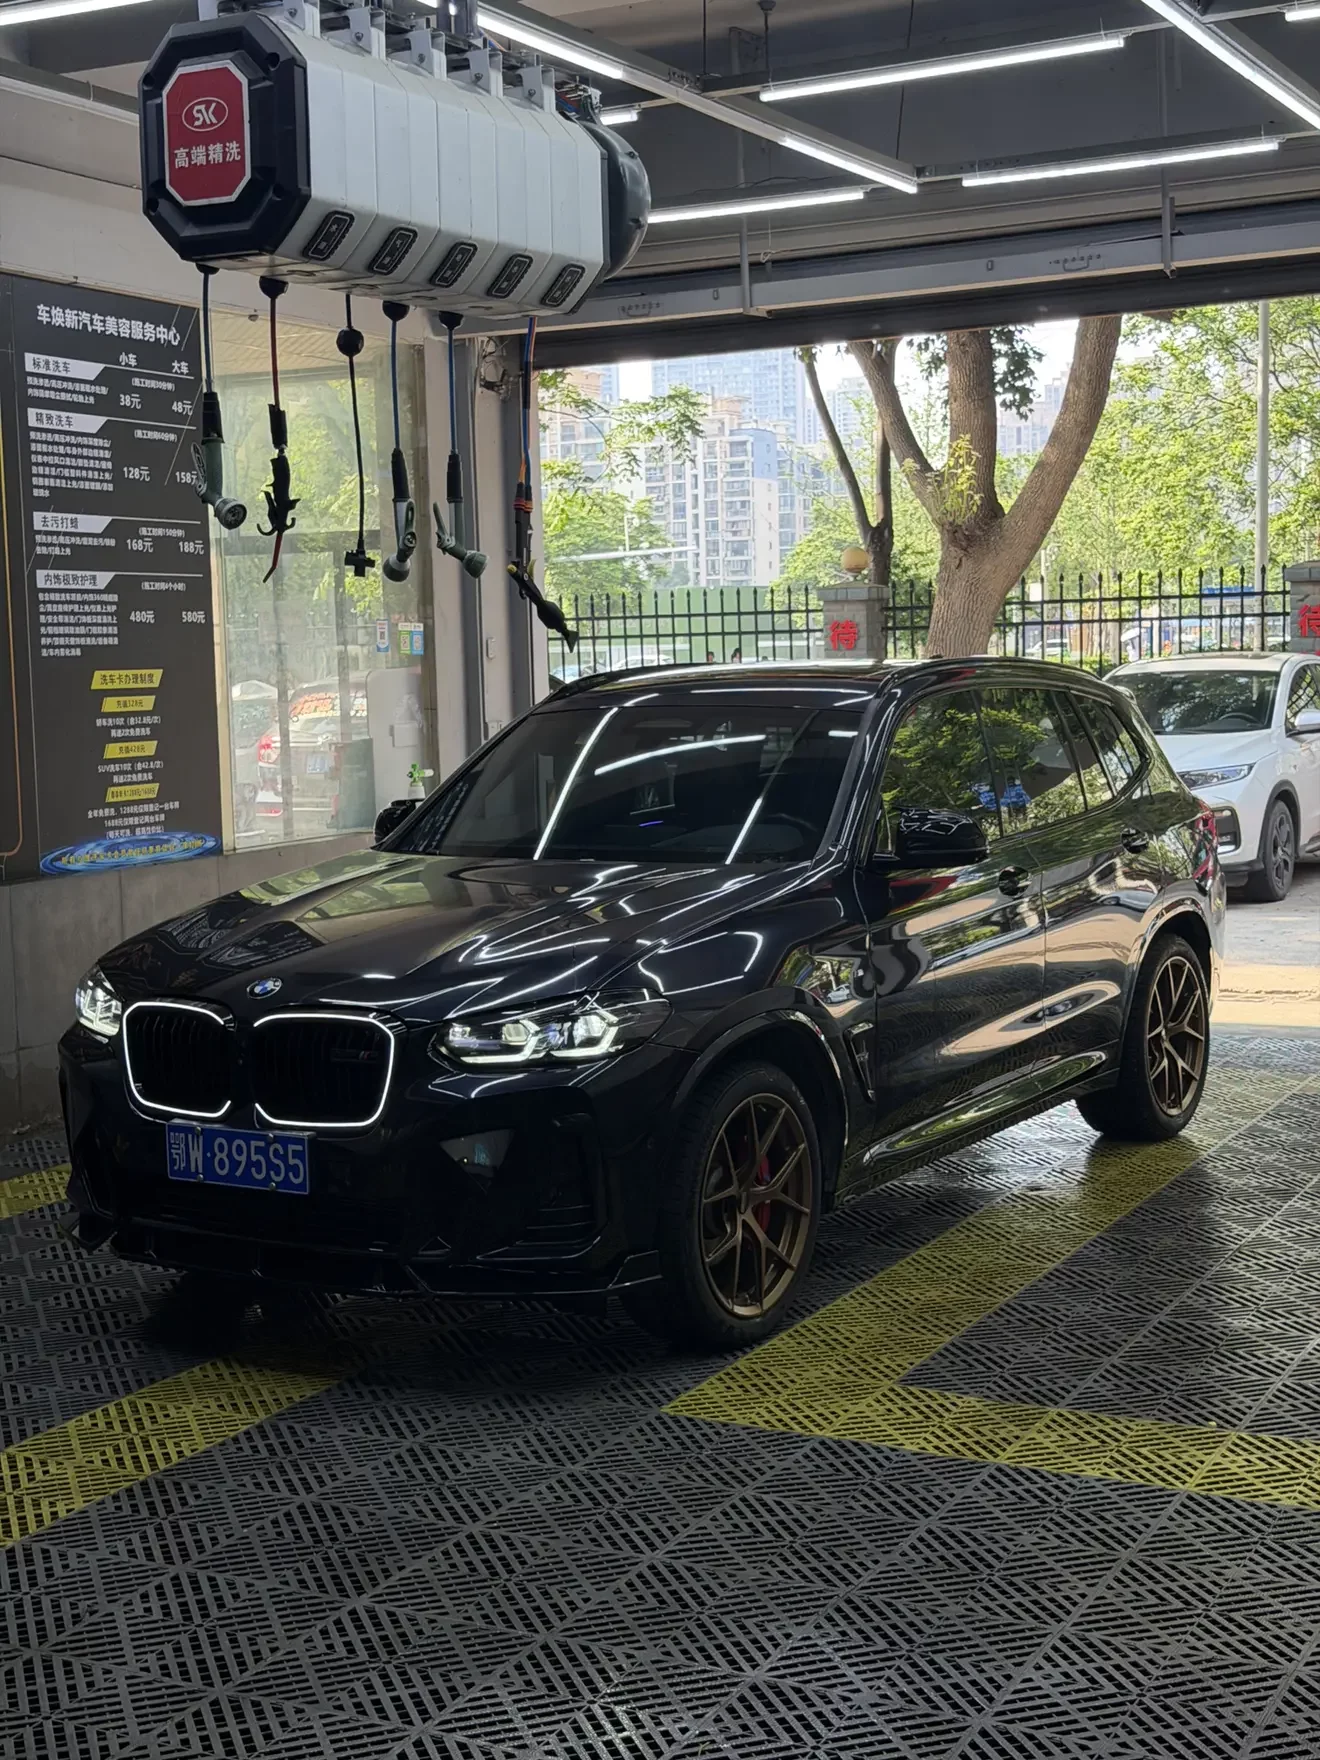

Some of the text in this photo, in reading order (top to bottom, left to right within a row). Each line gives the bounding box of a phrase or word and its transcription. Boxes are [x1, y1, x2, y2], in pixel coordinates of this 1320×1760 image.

[192, 102, 218, 127] SK
[174, 140, 241, 169] 高端精洗
[37, 304, 180, 346] 车焕新汽车美容服务中心
[32, 357, 71, 375] 标准洗车
[119, 352, 138, 368] 小车
[172, 360, 189, 375] 大车
[119, 393, 142, 409] 38元
[172, 400, 192, 415] 48元
[35, 411, 74, 428] 精致洗车
[123, 466, 150, 482] 128元
[41, 515, 78, 530] 去污打蜡
[126, 537, 153, 553] 168元
[179, 540, 205, 555] 188元
[44, 574, 98, 587] 内饰极致护理
[130, 611, 155, 624] 480元
[182, 611, 206, 624] 580元
[829, 618, 857, 651] 待
[100, 673, 155, 686] 洗车卡办理制度
[170, 1131, 304, 1185] 鄂W·895S5
